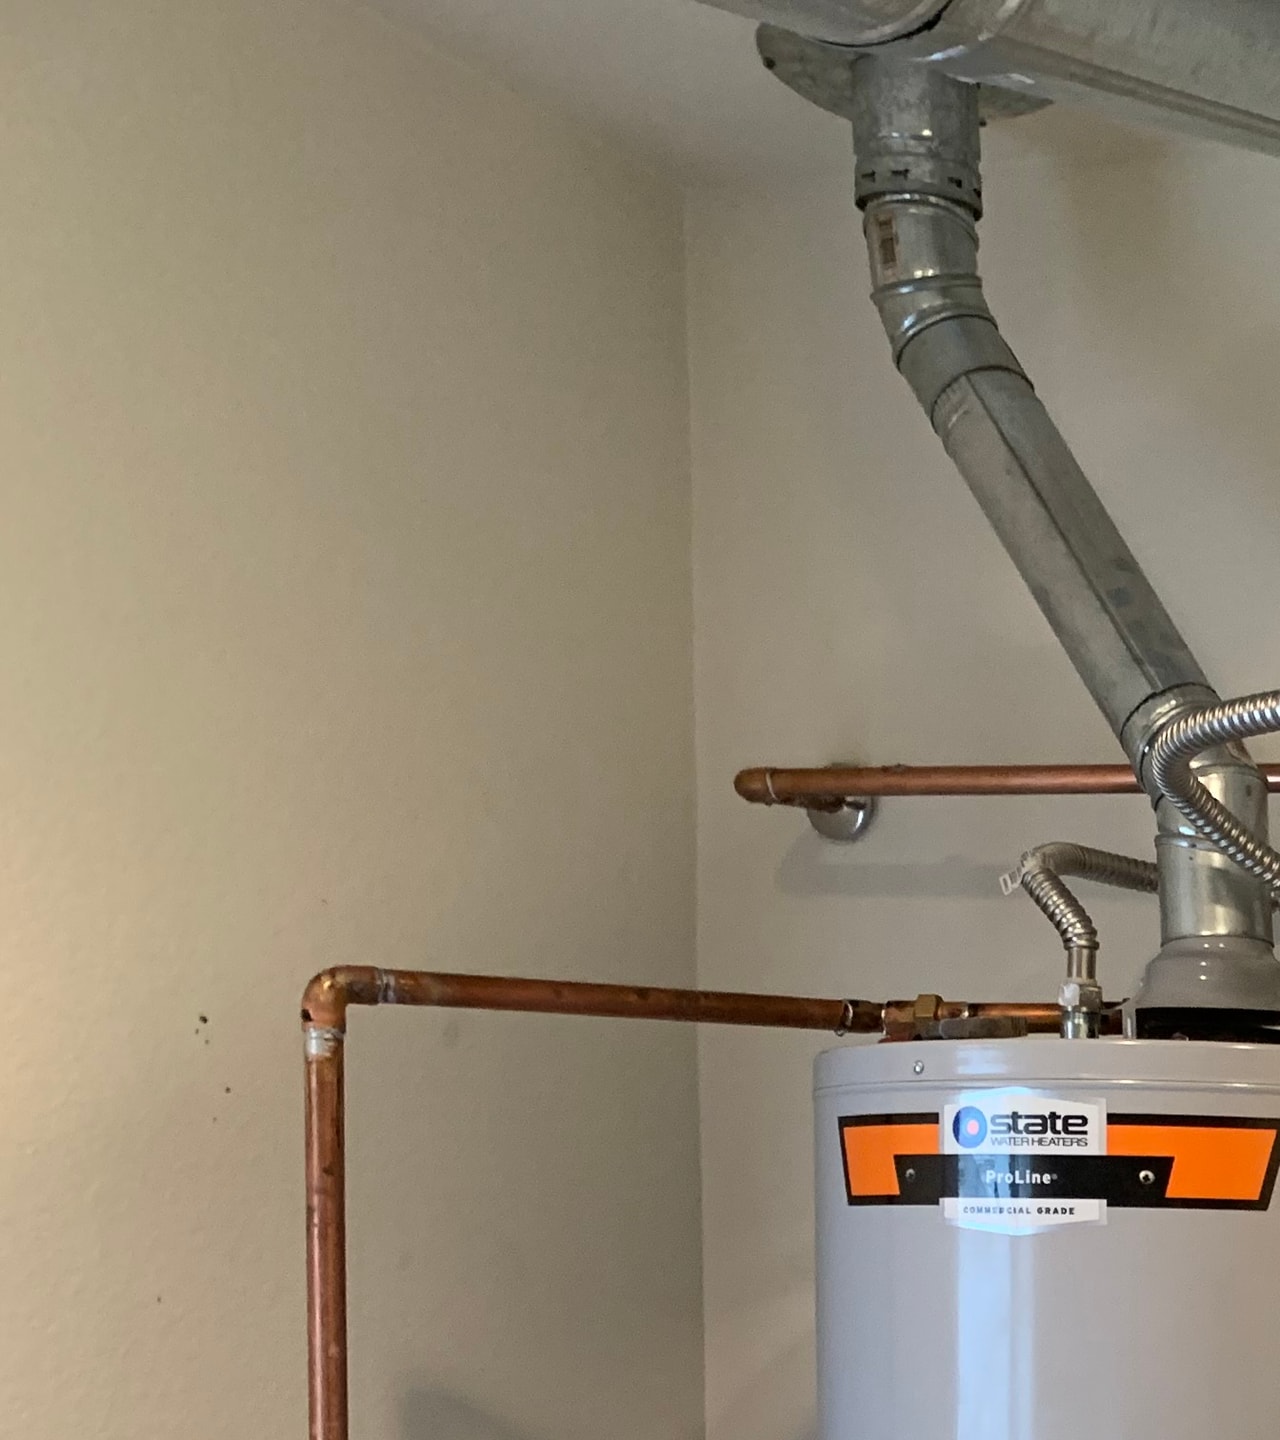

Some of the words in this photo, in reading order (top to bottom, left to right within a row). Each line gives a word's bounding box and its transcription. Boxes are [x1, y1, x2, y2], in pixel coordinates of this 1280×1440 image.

[990, 1111, 1088, 1135] state
[991, 1137, 1029, 1146] WATER
[1032, 1138, 1088, 1147] HEATERS
[1037, 1207, 1075, 1215] GRADE
